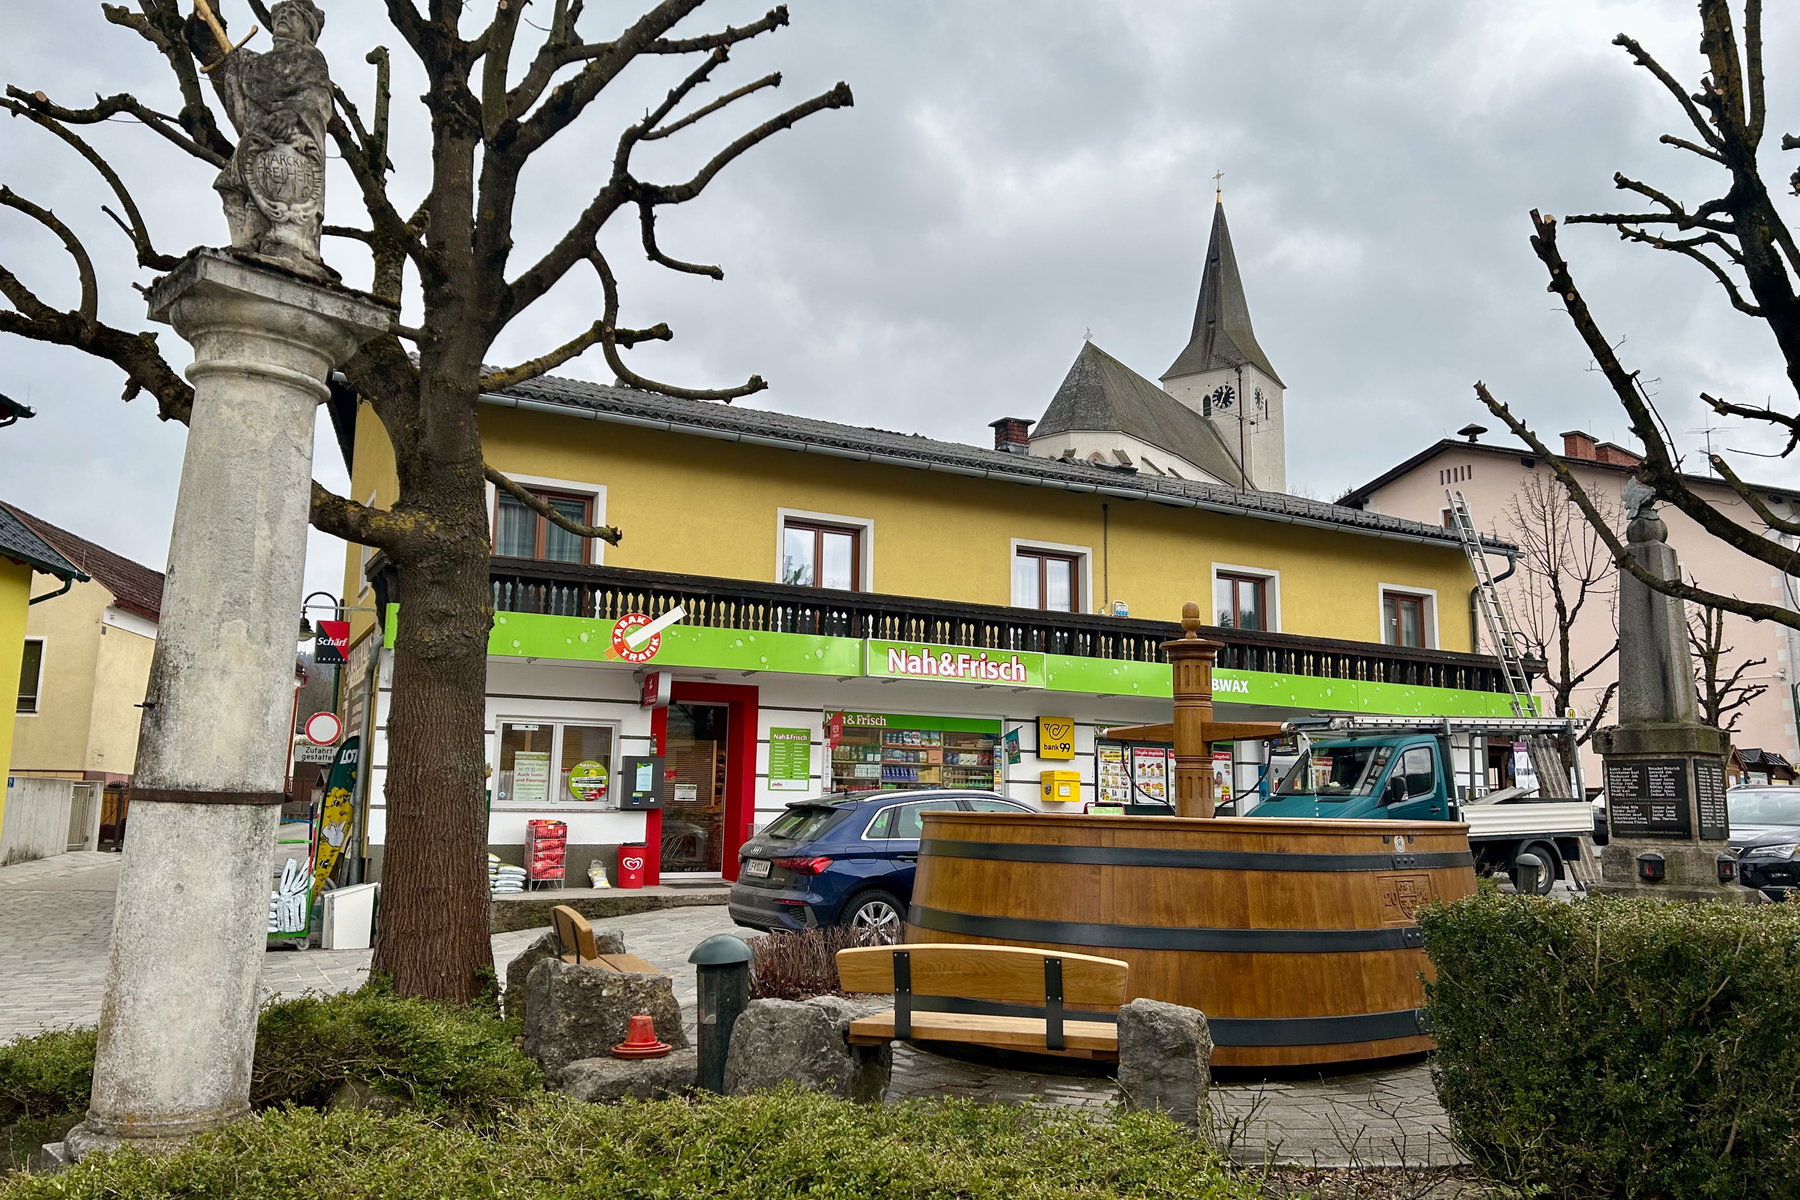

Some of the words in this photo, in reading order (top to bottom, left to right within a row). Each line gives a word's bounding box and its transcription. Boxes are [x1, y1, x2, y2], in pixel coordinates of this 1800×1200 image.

[613, 615, 646, 644] TABAK
[317, 636, 348, 647] Schärf
[621, 637, 659, 661] TRAFIK
[887, 648, 1027, 683] Nah&Frisch
[825, 713, 887, 726] N&Frisch
[773, 733, 808, 741] Nah&Frisch
[305, 746, 333, 754] Zufahrt
[301, 753, 335, 762] gestattet
